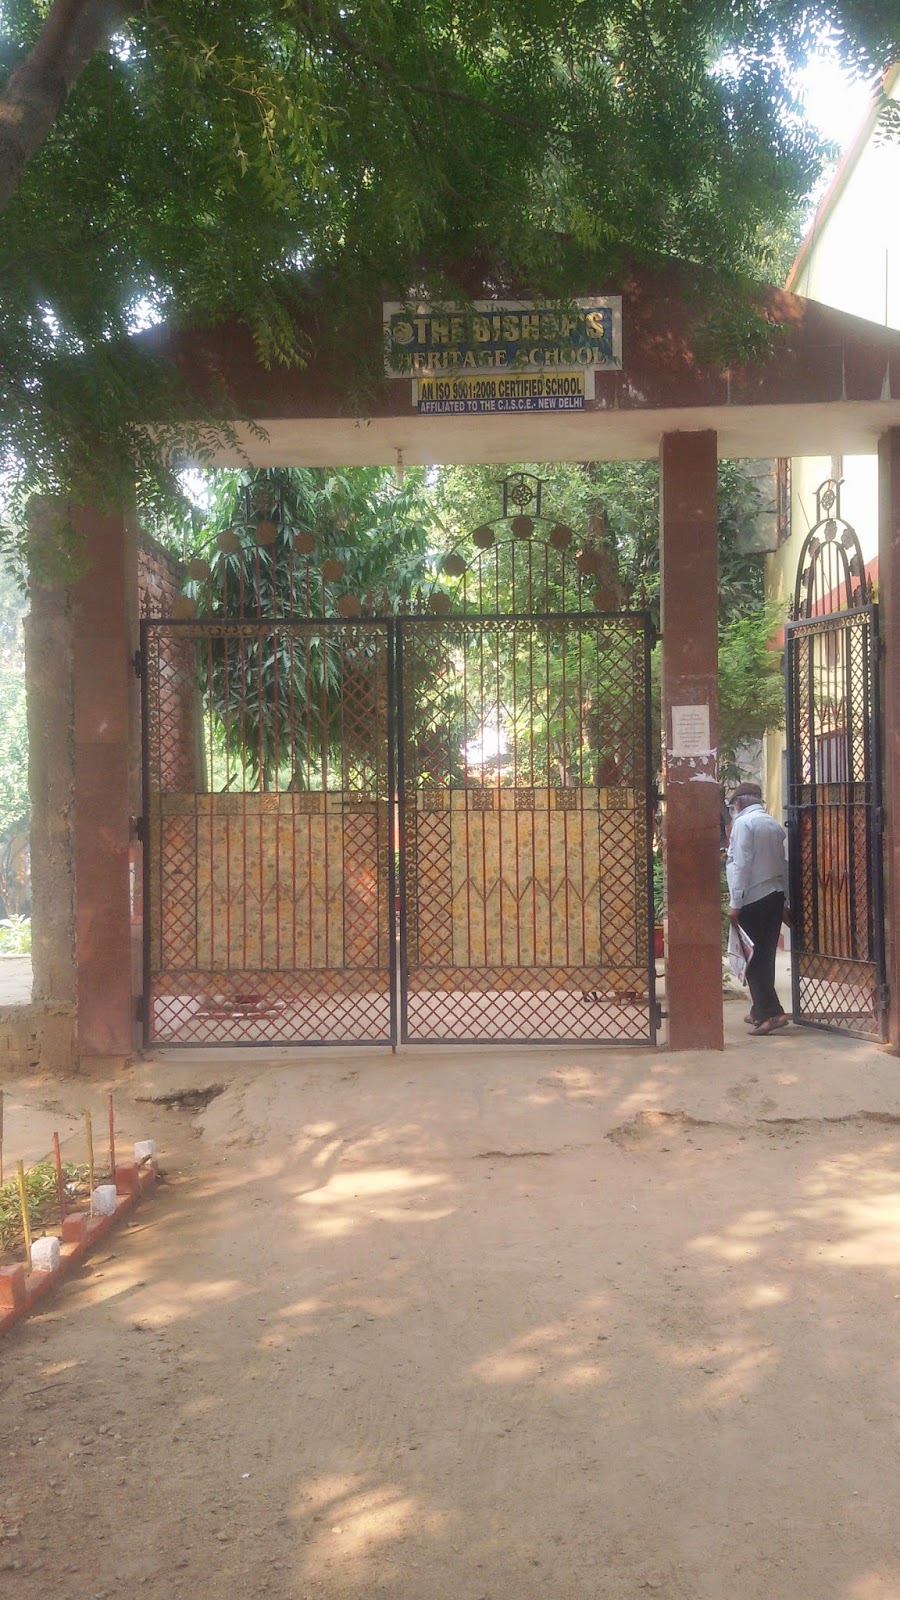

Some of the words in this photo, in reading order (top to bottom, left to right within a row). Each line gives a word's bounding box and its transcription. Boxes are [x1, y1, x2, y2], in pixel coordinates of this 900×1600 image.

[413, 317, 465, 345] THE
[422, 384, 433, 400] AN
[436, 382, 451, 399] ISO
[453, 381, 496, 399] 9001:2008
[498, 379, 543, 398] CERTIFIED
[545, 377, 582, 396] SCHOOL
[420, 401, 465, 413] AFFILIATED
[467, 401, 478, 412] TO
[480, 400, 496, 411] THE
[538, 398, 557, 409] NEW
[558, 397, 583, 408] DELHI
